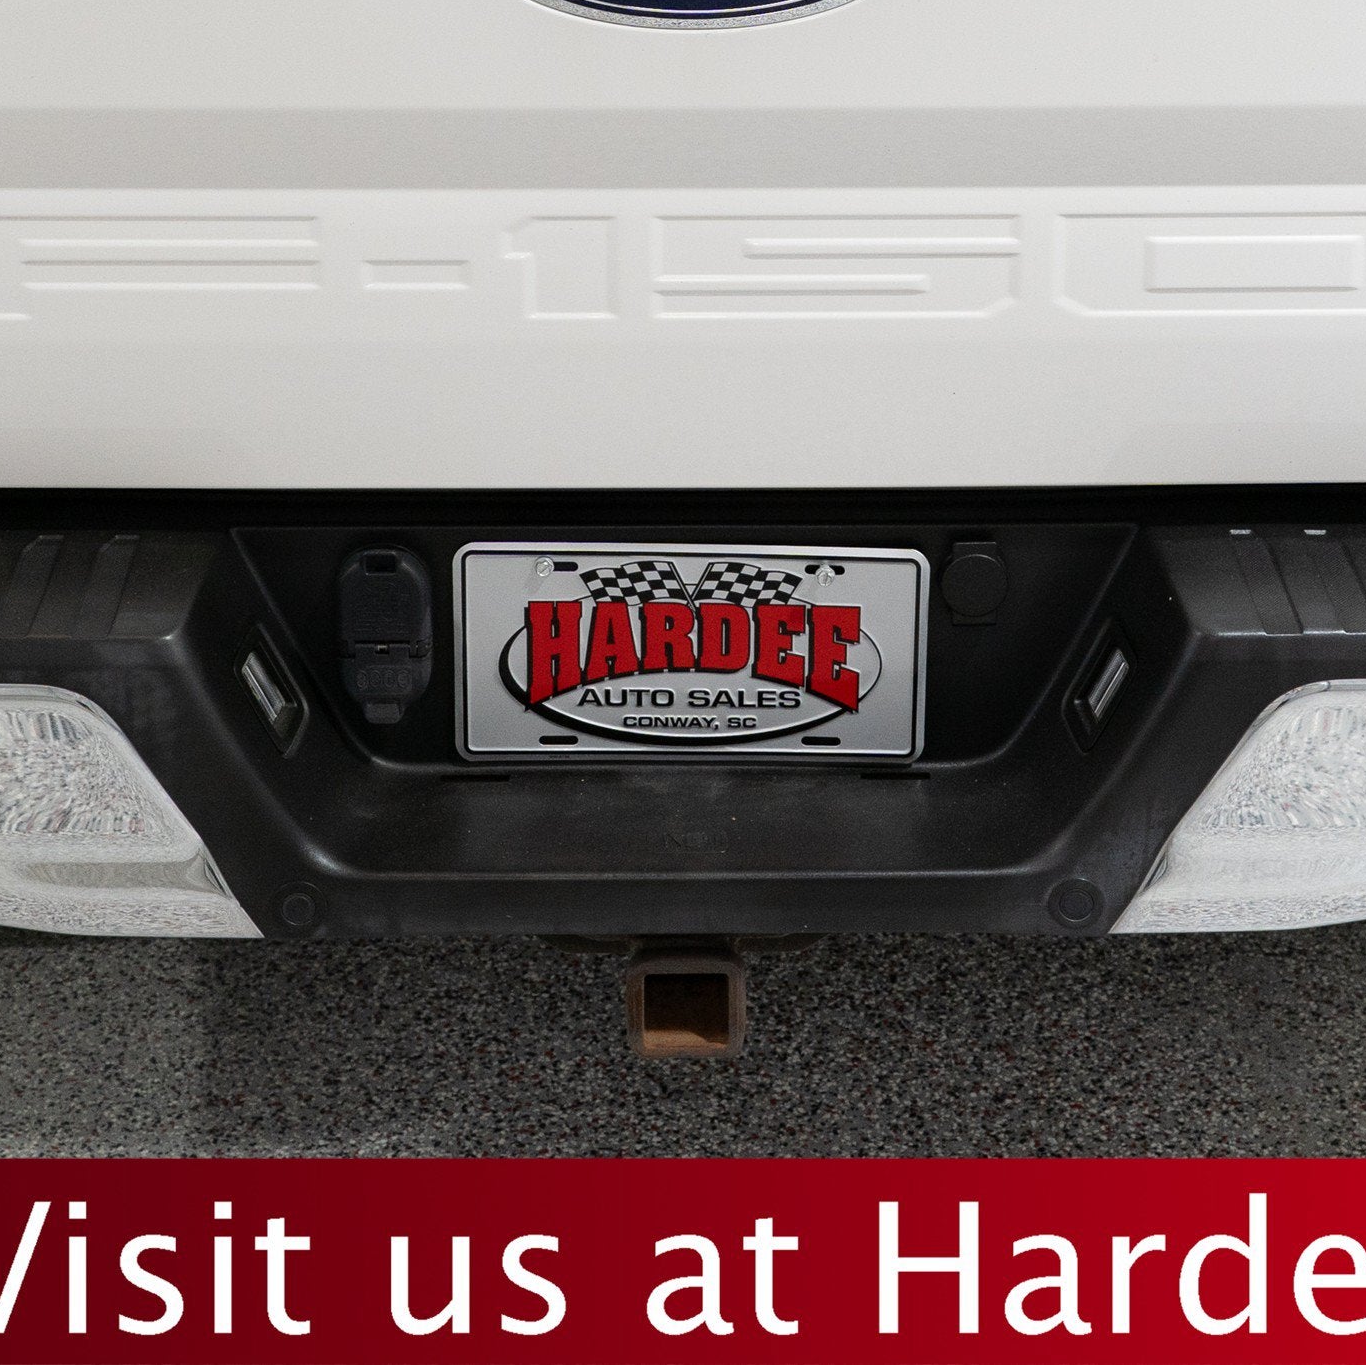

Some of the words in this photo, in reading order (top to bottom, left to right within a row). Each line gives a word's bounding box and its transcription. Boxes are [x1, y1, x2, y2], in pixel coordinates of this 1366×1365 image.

[525, 600, 862, 713] HARDEE
[577, 687, 675, 708] AUTO
[687, 688, 802, 709] SALES
[622, 714, 720, 731] CONWAY,
[726, 715, 758, 729] SC
